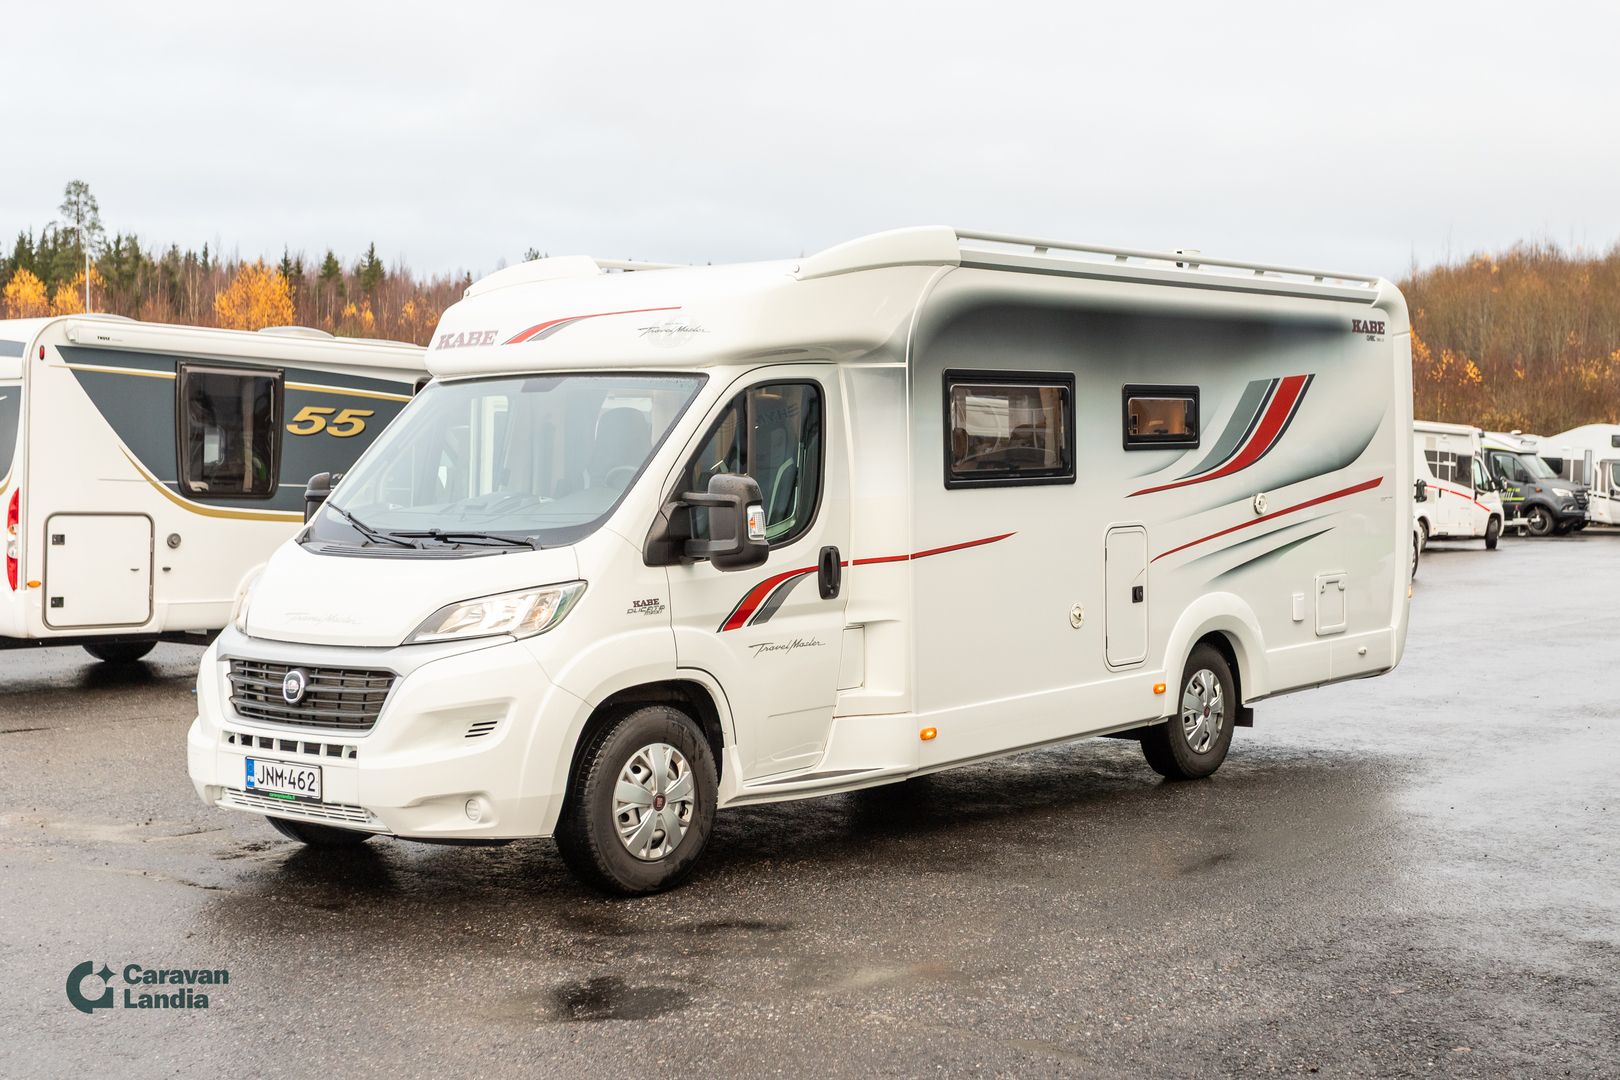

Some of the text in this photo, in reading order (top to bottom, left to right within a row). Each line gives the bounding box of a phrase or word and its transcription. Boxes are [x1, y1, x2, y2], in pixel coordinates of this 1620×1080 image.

[1352, 318, 1385, 335] KABE
[435, 330, 499, 350] KABE
[286, 406, 375, 438] 55
[632, 598, 660, 608] KABE
[257, 765, 316, 793] JNM-462
